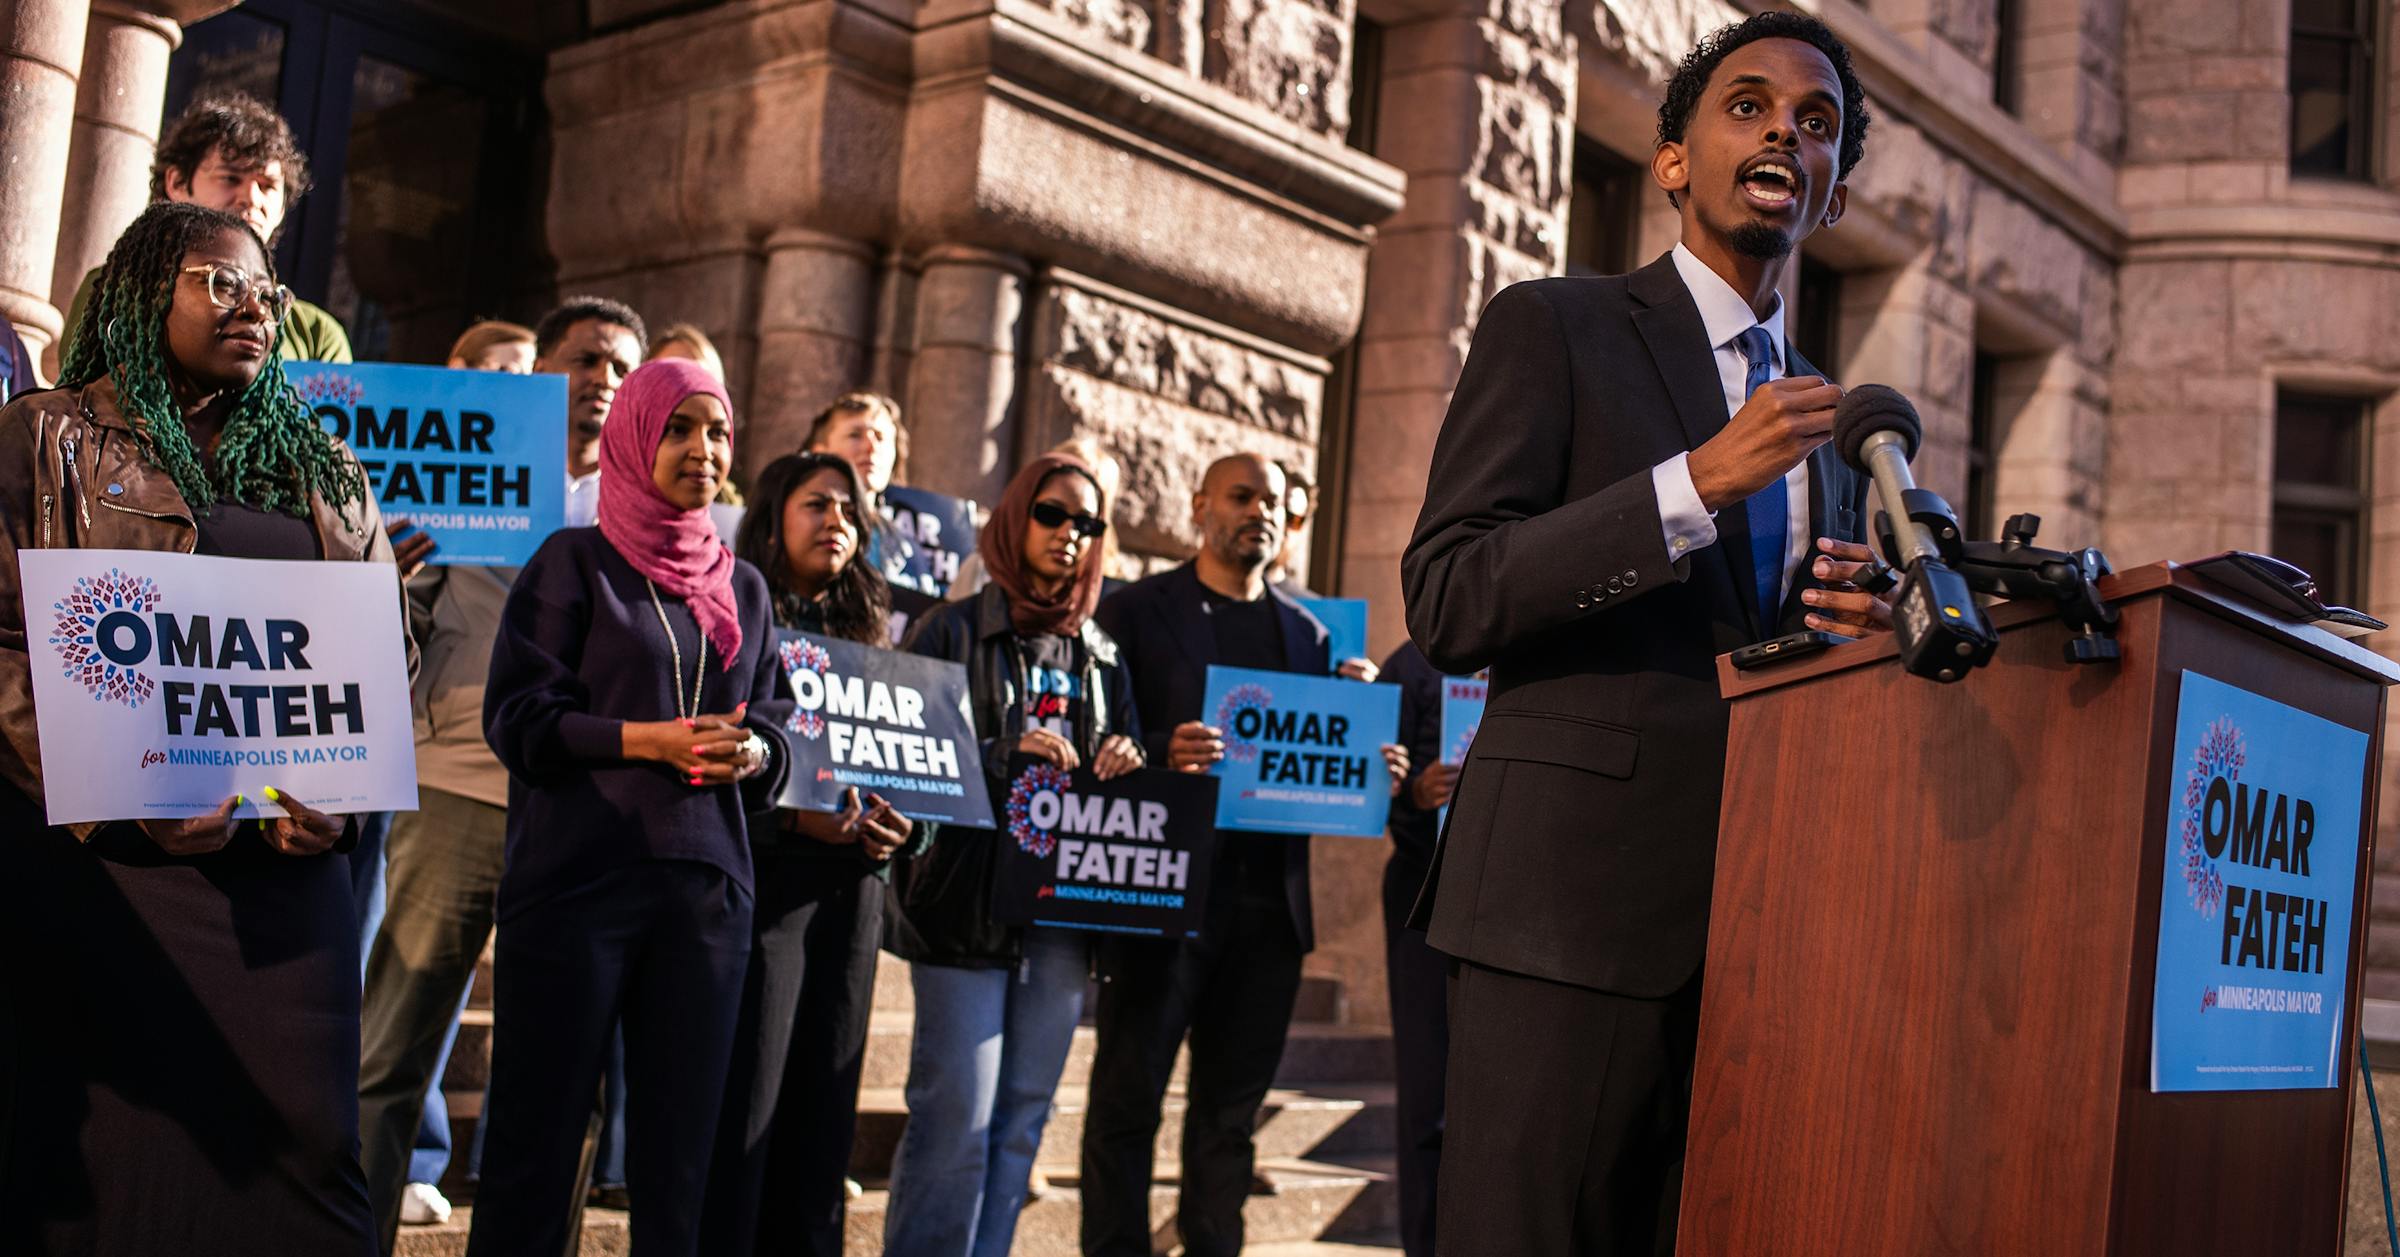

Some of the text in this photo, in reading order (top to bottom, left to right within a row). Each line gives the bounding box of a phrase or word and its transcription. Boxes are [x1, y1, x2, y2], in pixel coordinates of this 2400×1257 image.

[469, 514, 531, 531] MAYOR
[96, 611, 312, 671] OMAR
[162, 681, 365, 738] FATEH
[789, 668, 926, 730] OMAR
[827, 721, 961, 779] FATEH
[1236, 708, 1349, 747] OMAR
[141, 745, 368, 768] for MINNEAPOLIS MAYOR
[1259, 750, 1368, 788] FATEH
[833, 768, 917, 791] MINNEAPOLIS
[919, 780, 965, 797] MAYOR
[1029, 789, 1168, 842] OMAR
[2202, 775, 2315, 877] OMAR
[1056, 839, 1190, 890] FATEH
[1055, 884, 1138, 905] MINNEAPOLIS
[1140, 892, 1185, 909] MAYOR
[2220, 885, 2328, 975] FATEH
[2201, 984, 2322, 1014] for MINNEAPOLIS MAYOR
